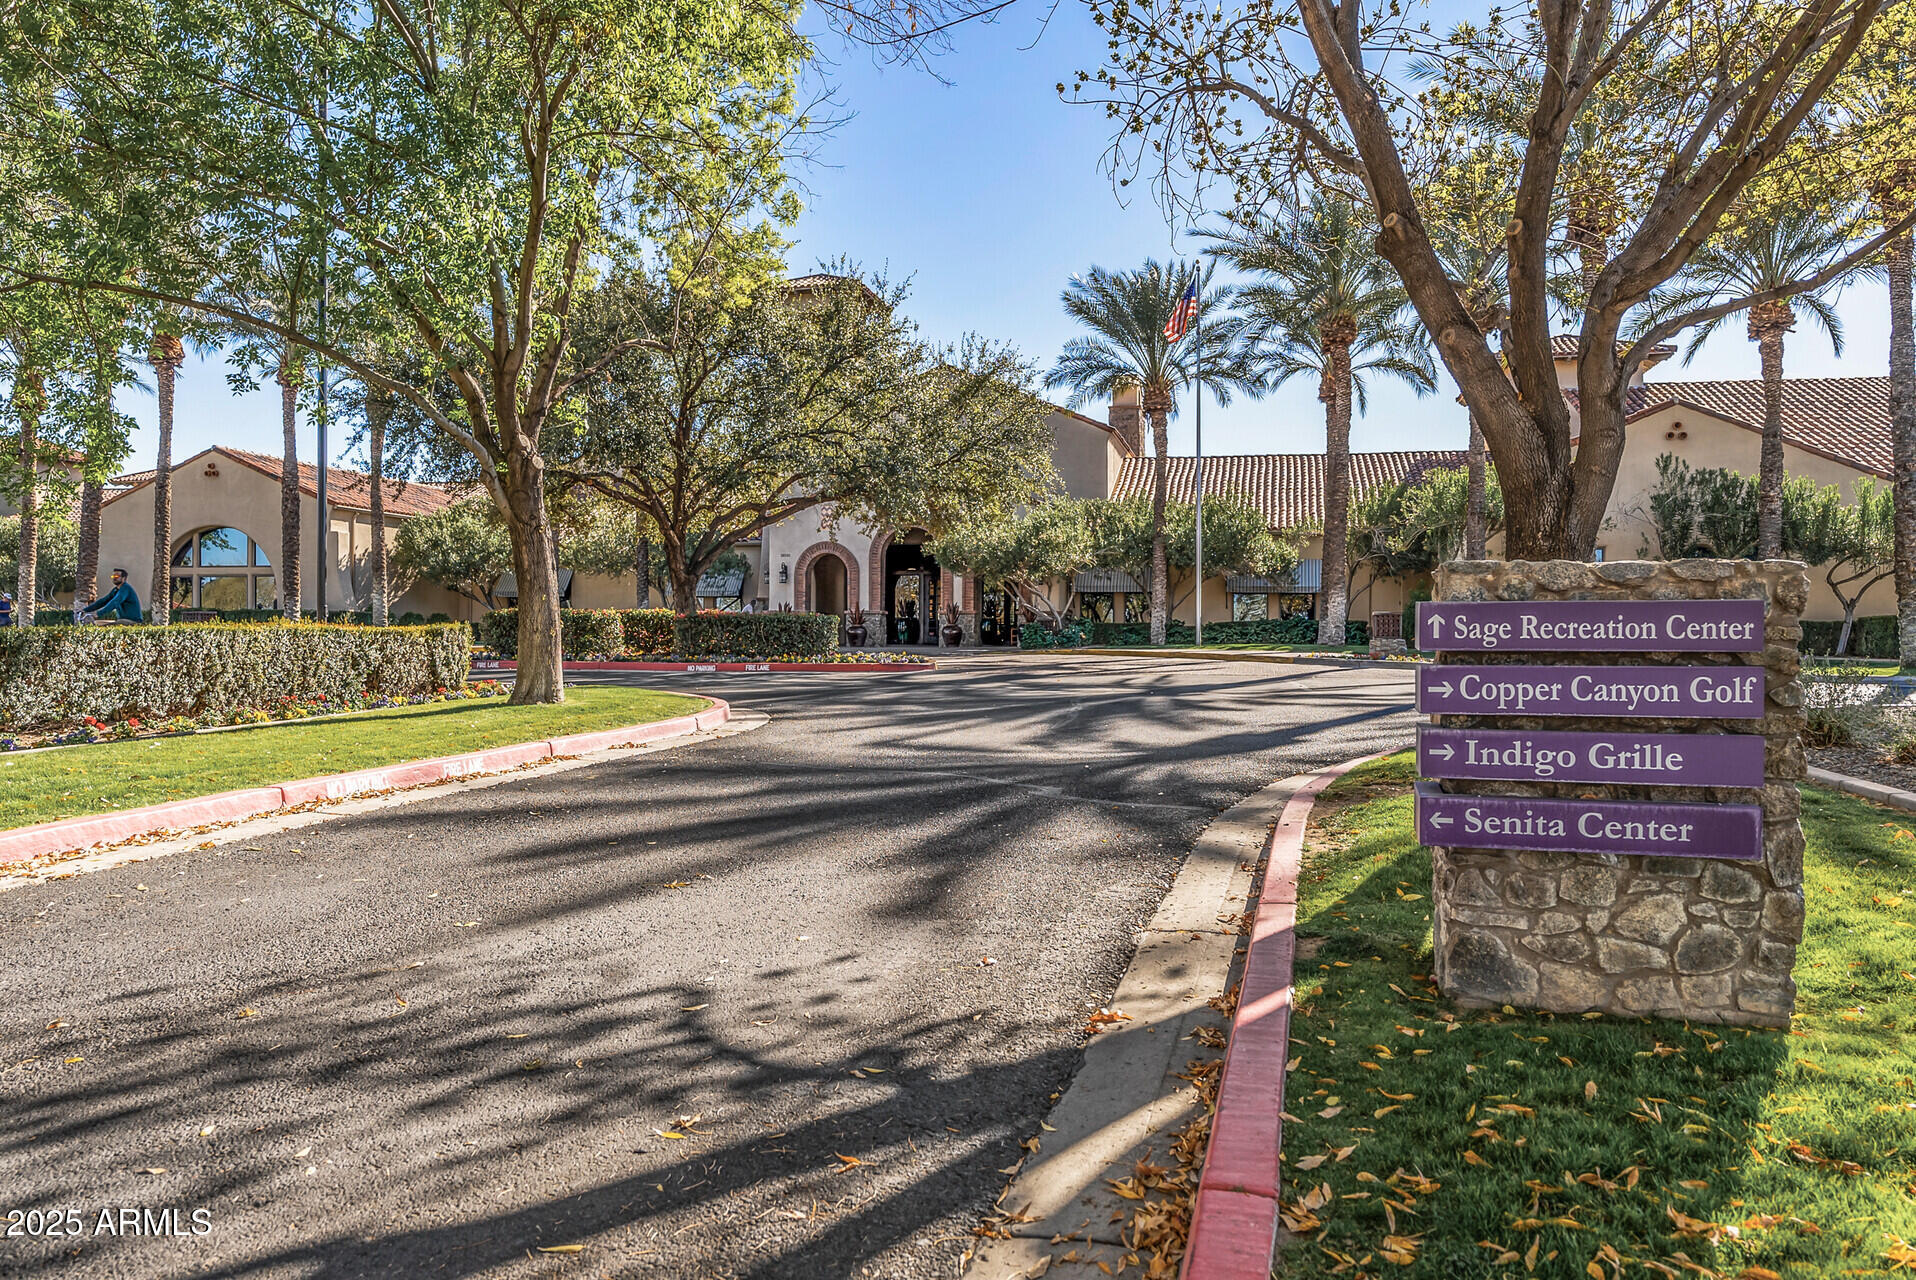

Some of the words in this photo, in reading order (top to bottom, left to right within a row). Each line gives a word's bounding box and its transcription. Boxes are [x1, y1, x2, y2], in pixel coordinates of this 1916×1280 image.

[1454, 615, 1512, 647] Sage
[1519, 615, 1657, 640] Recreation
[1665, 615, 1755, 640] Center
[1459, 675, 1562, 710] Copper
[1571, 675, 1681, 711] Canyon
[1689, 677, 1757, 704] Golf
[1464, 739, 1577, 776] Indigo
[1588, 742, 1684, 771] Grille
[326, 781, 344, 798] NO
[1464, 807, 1567, 837] Senita
[1577, 812, 1694, 842] Center
